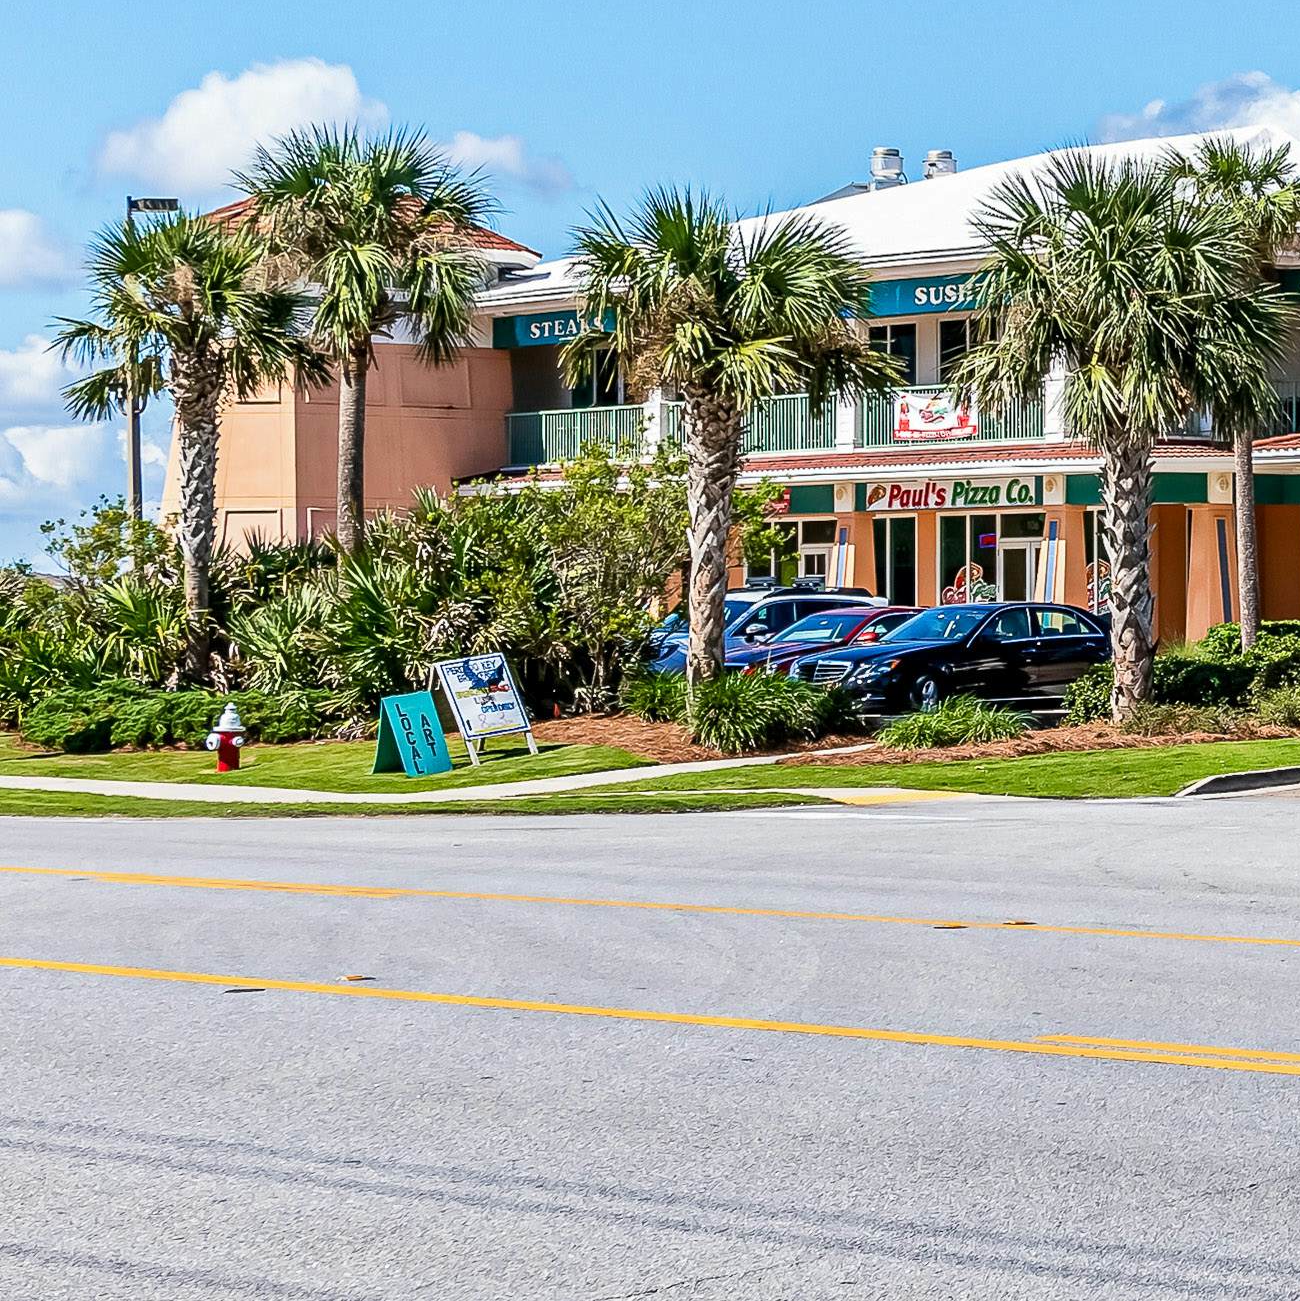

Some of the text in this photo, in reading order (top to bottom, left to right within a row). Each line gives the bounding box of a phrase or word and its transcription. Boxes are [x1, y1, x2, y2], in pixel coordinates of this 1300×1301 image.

[887, 478, 1034, 509] Paul's Pizza Co.
[395, 703, 425, 774] LOCAL
[421, 713, 437, 757] ART
